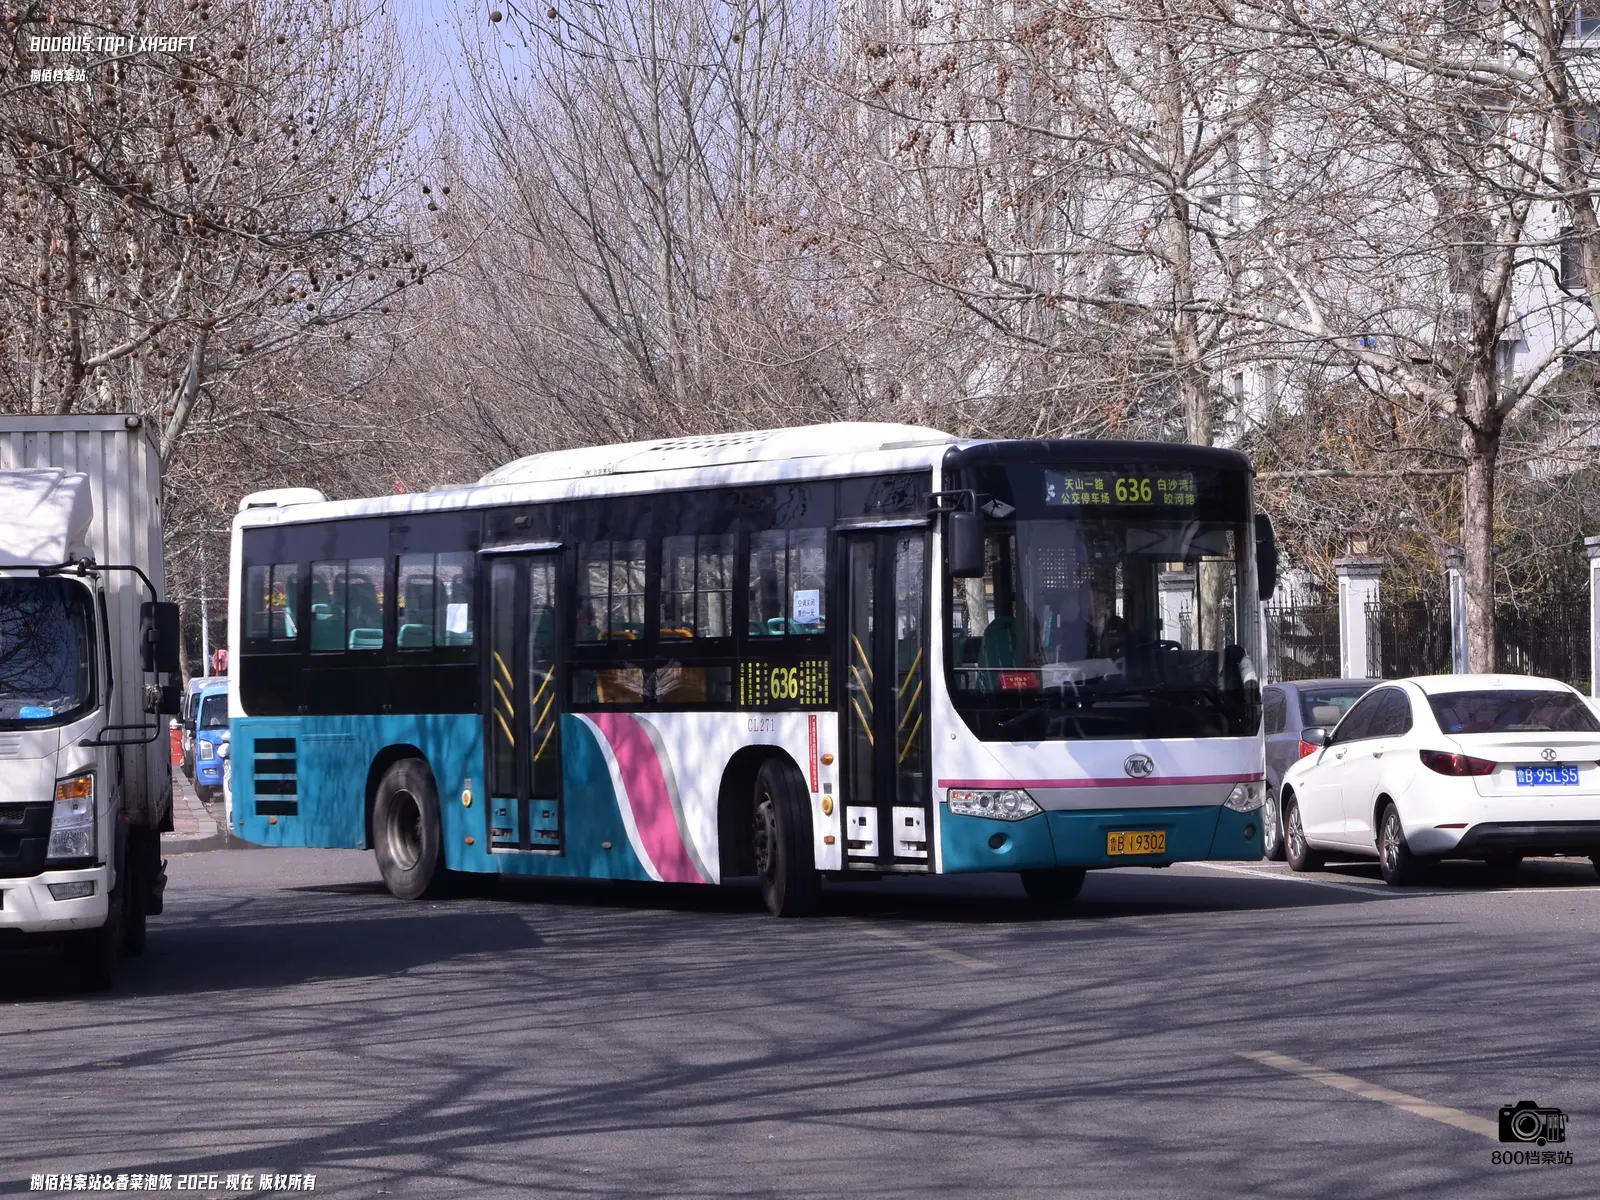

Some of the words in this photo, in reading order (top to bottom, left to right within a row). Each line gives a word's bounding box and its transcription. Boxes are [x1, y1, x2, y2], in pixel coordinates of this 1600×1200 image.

[1065, 478, 1104, 490] 天山一路
[1115, 478, 1152, 501] 636
[1061, 492, 1111, 505] 公交停车场
[770, 667, 798, 699] 636
[747, 718, 775, 732] CL271
